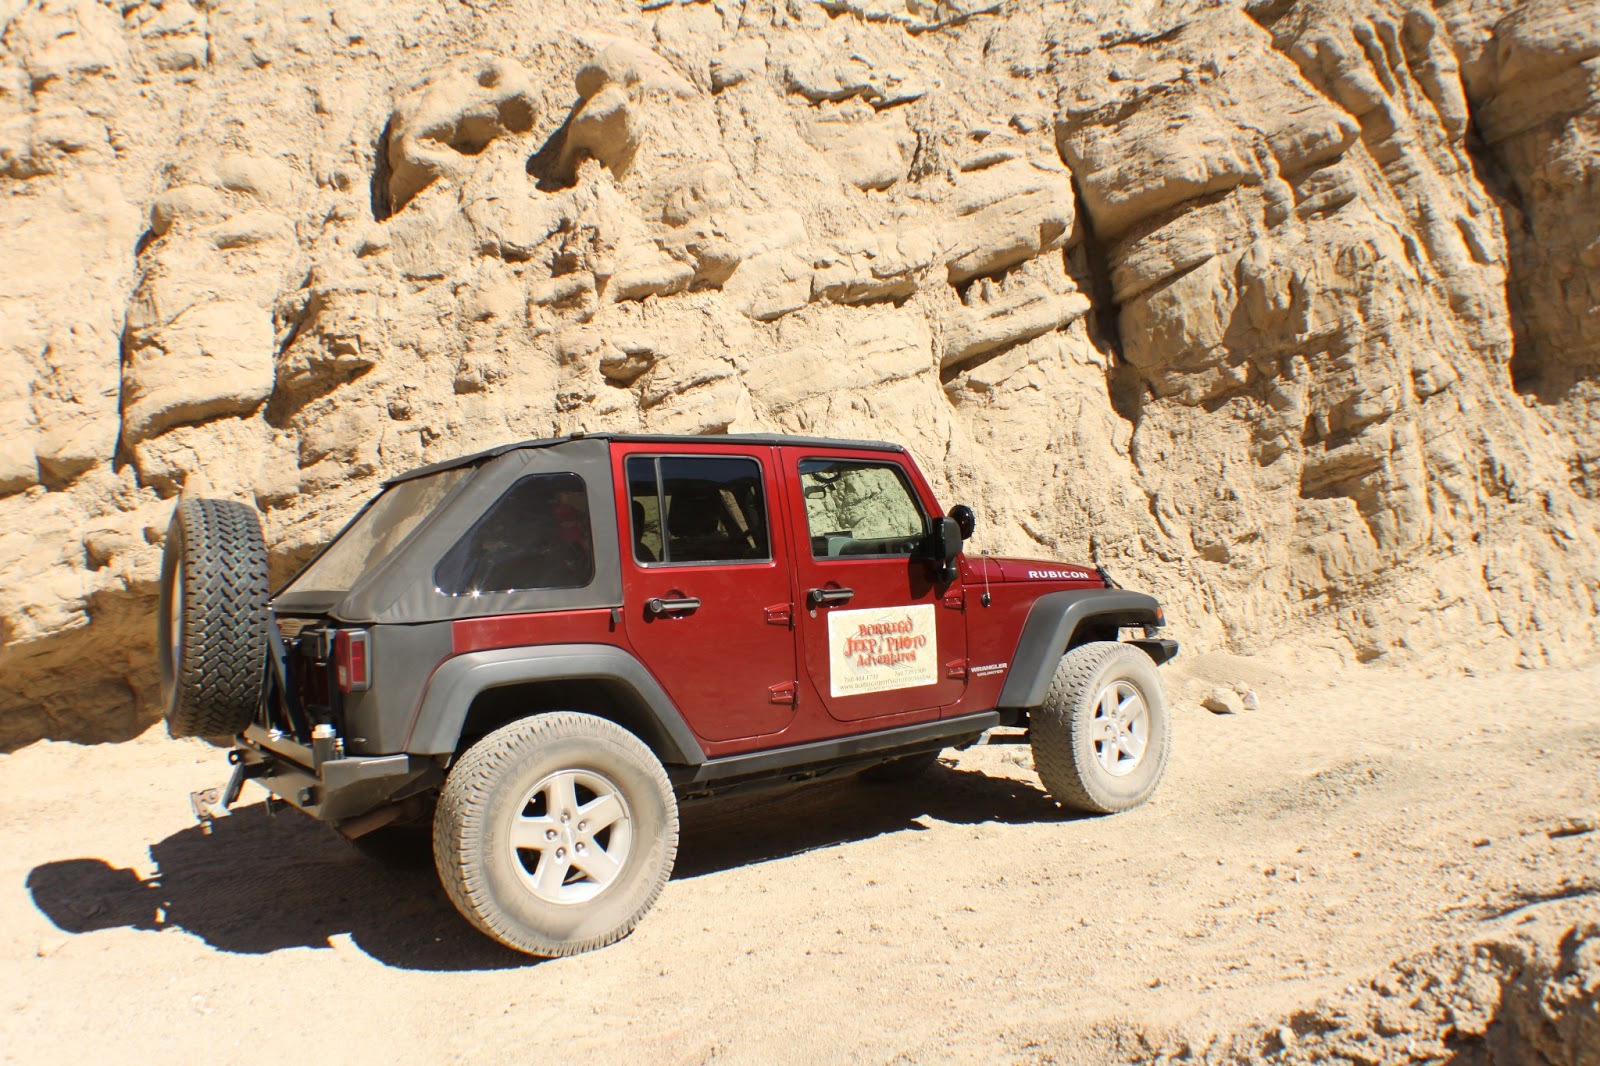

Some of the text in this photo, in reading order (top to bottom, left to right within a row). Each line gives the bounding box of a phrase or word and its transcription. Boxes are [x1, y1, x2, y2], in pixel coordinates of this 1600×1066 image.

[1028, 570, 1089, 579] RUBICON
[885, 634, 927, 652] PHOTO
[857, 651, 916, 667] Adventures
[971, 663, 1007, 672] WRANGLER
[977, 669, 1004, 677] UNLIMITED
